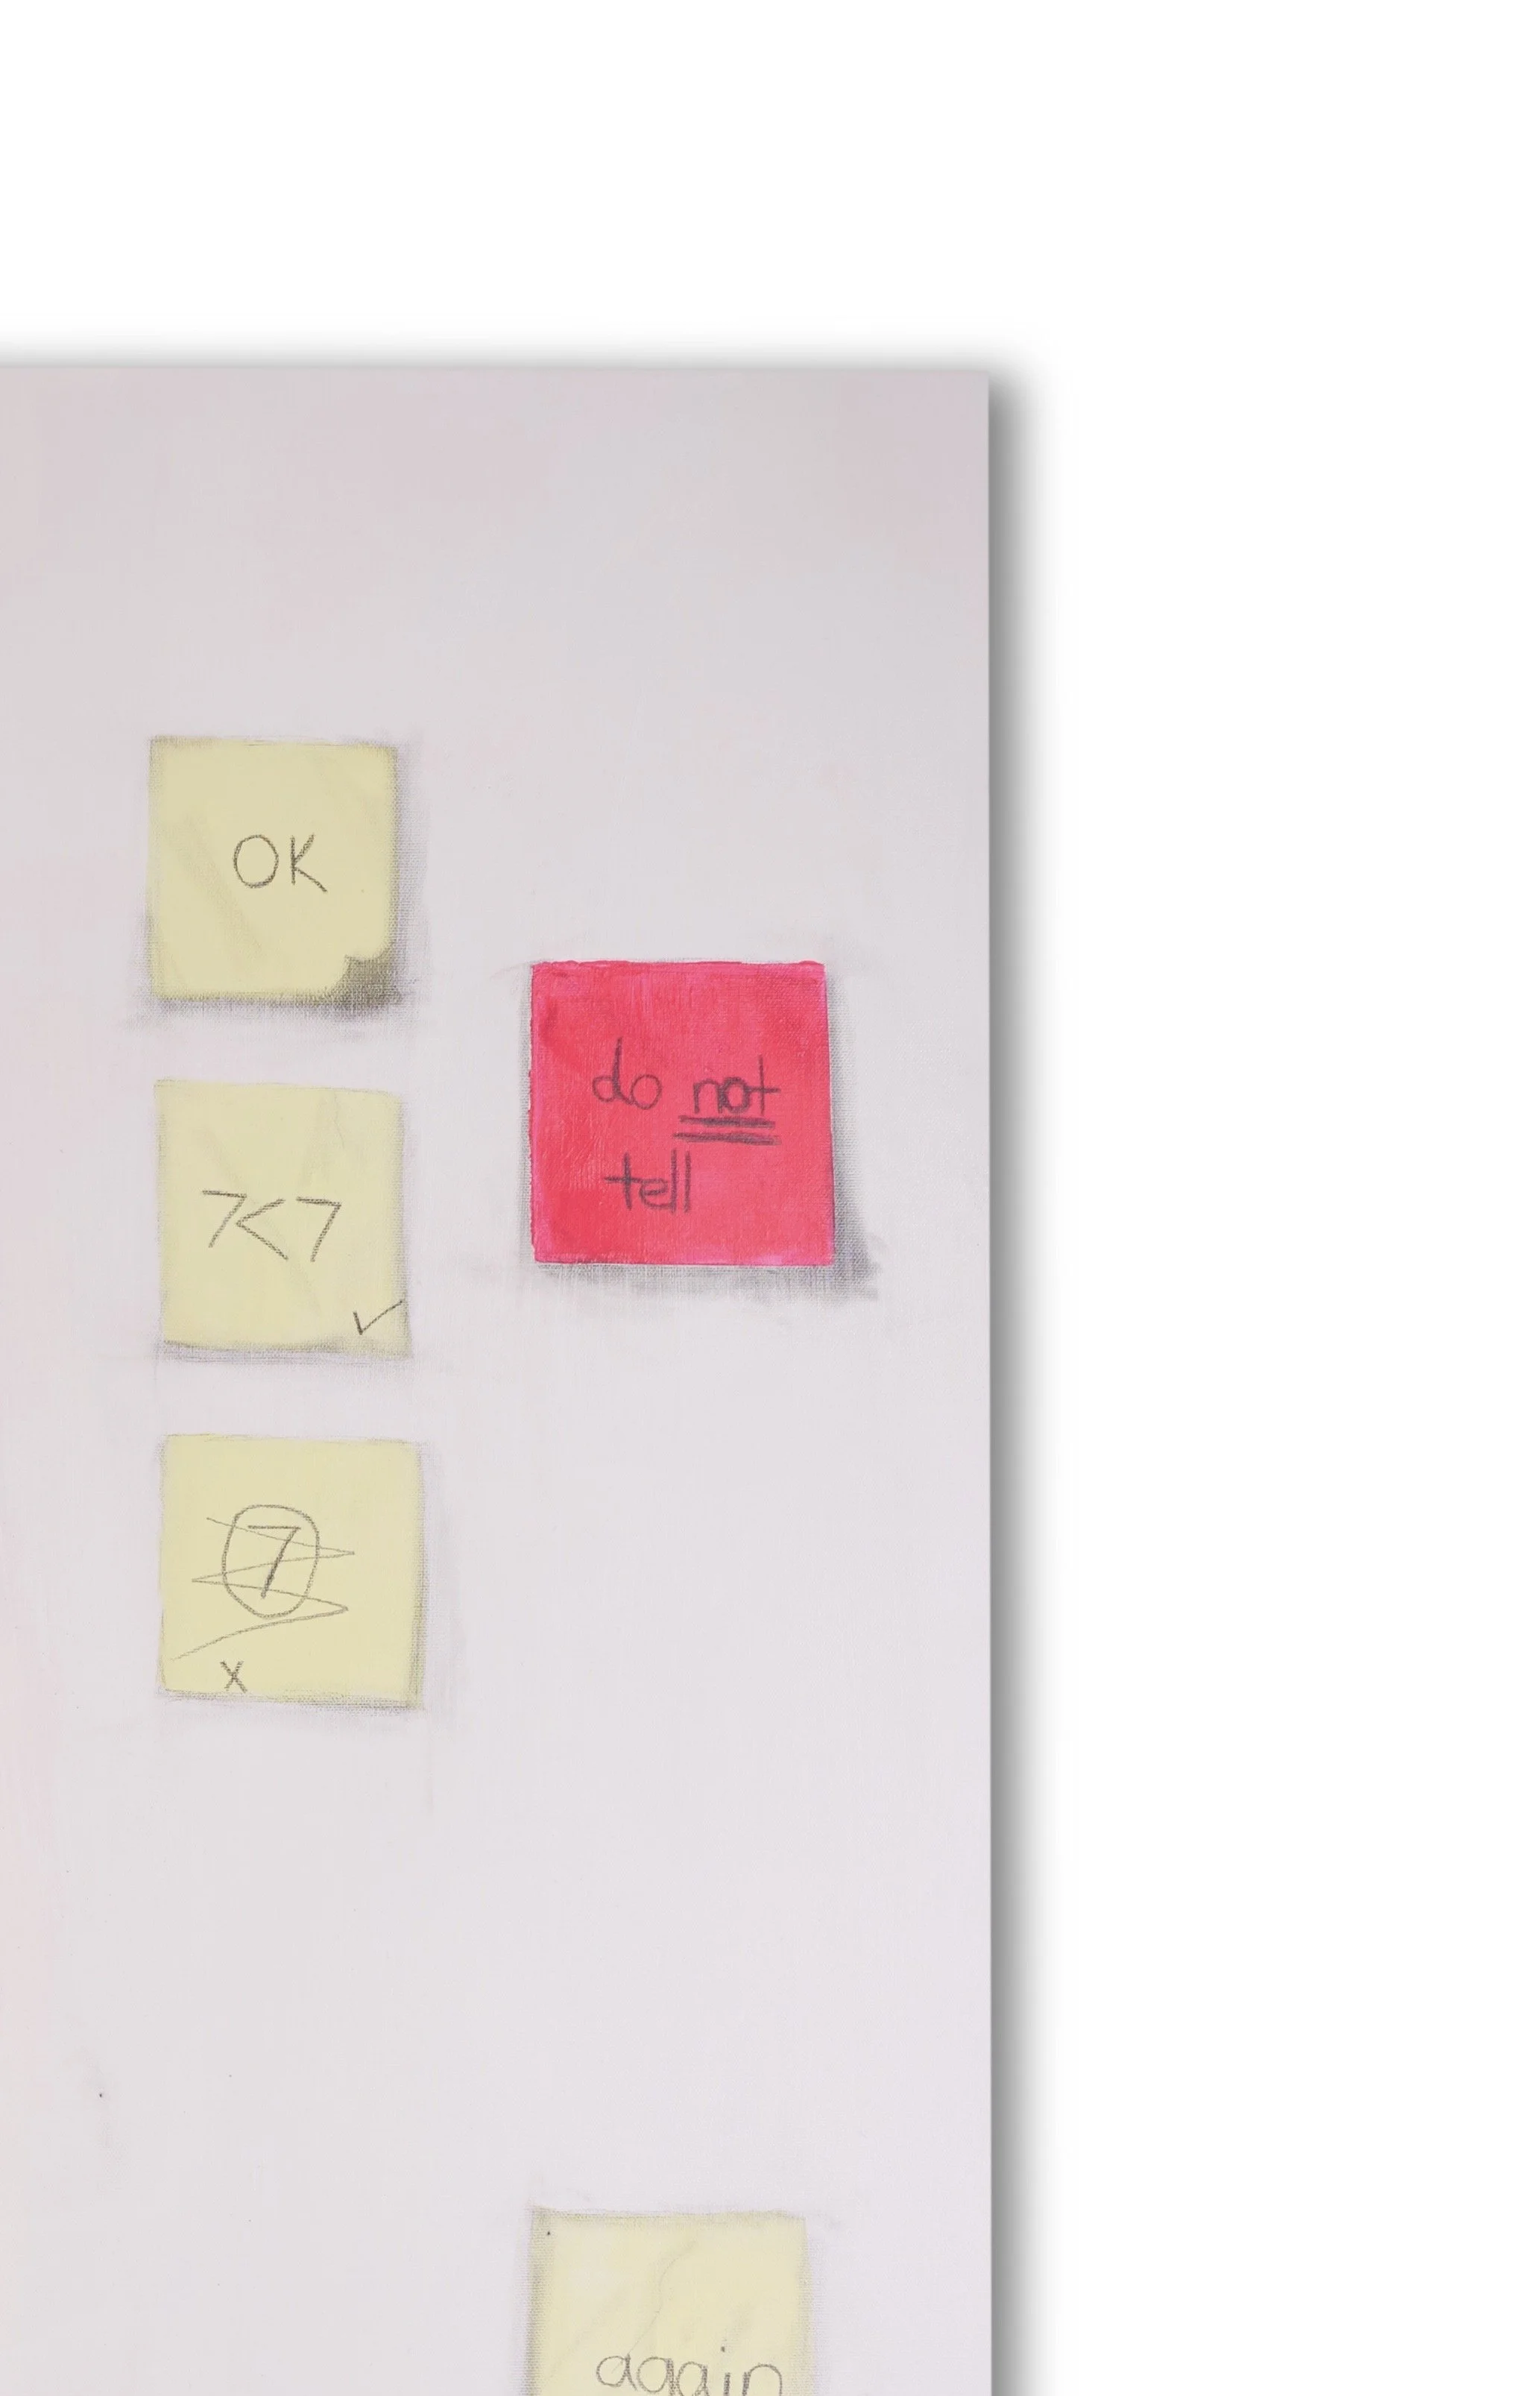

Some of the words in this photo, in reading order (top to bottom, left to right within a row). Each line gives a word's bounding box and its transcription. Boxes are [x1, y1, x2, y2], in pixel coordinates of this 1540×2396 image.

[233, 833, 328, 893] OK
[592, 1036, 663, 1110] do
[692, 1054, 781, 1115] not
[602, 1148, 692, 1214] tell
[247, 1525, 302, 1599] 7
